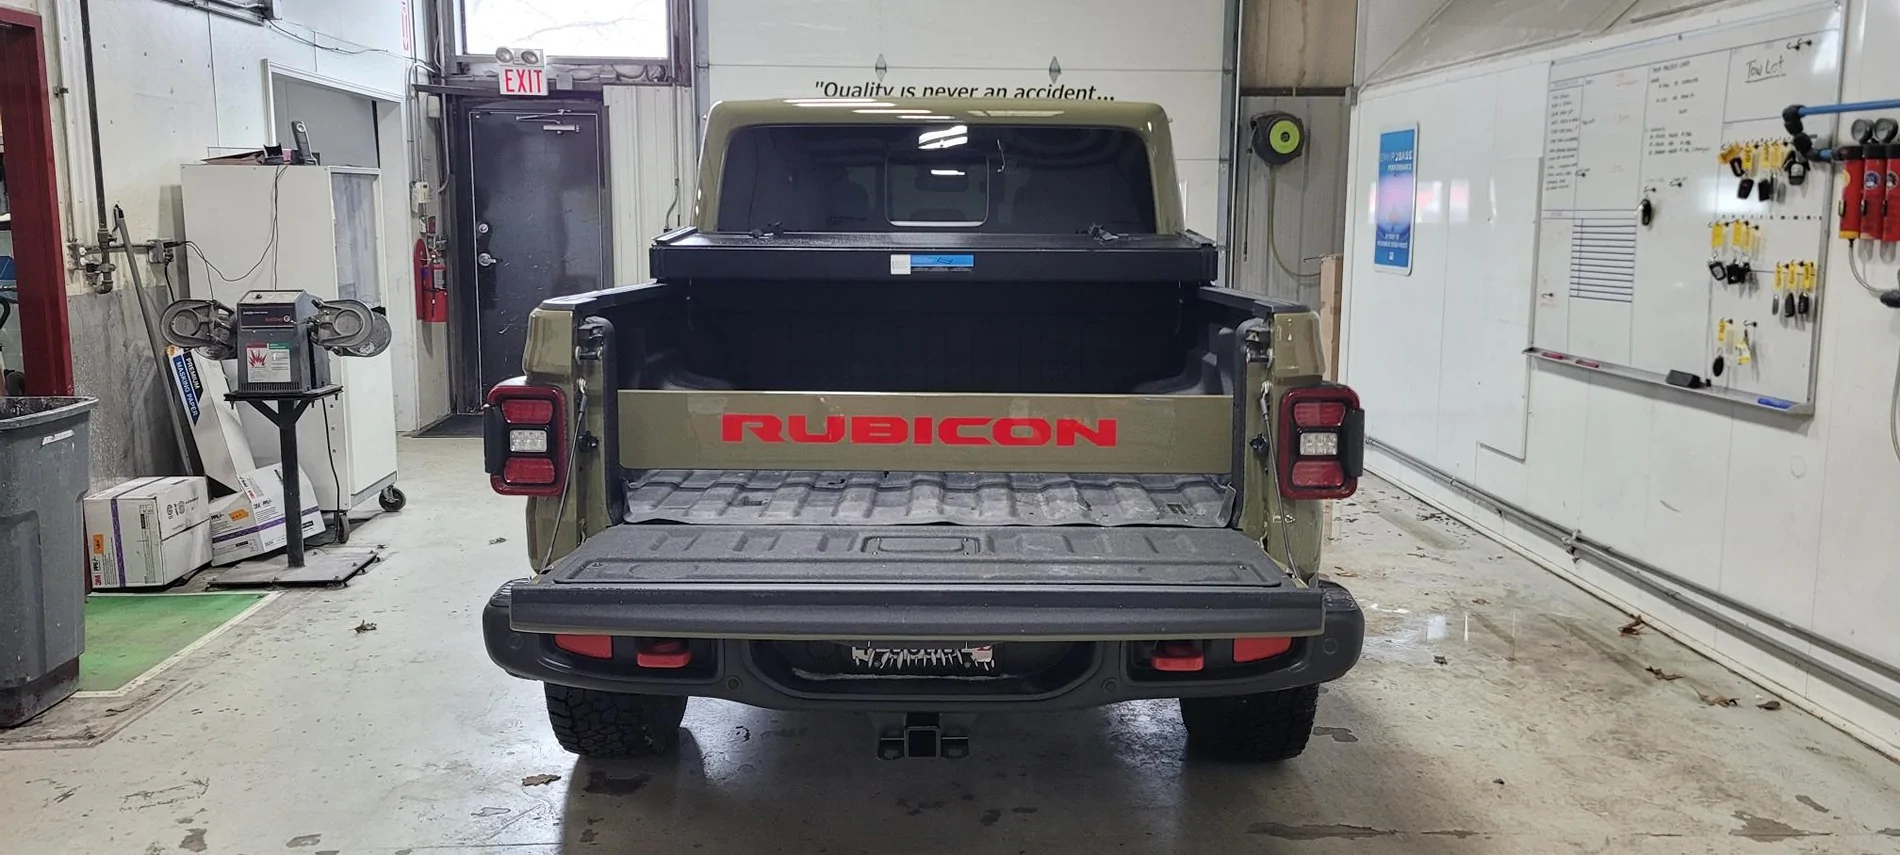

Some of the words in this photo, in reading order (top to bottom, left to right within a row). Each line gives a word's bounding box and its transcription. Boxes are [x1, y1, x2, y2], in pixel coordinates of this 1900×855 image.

[1764, 54, 1785, 75] Lot
[504, 68, 543, 93] EXIT
[900, 86, 916, 97] is
[922, 85, 978, 98] never
[984, 86, 1008, 98] an
[186, 358, 200, 389] PREMIUM
[176, 361, 189, 393] MASKING
[186, 394, 198, 416] PAPER
[721, 413, 1117, 447] RUBICON
